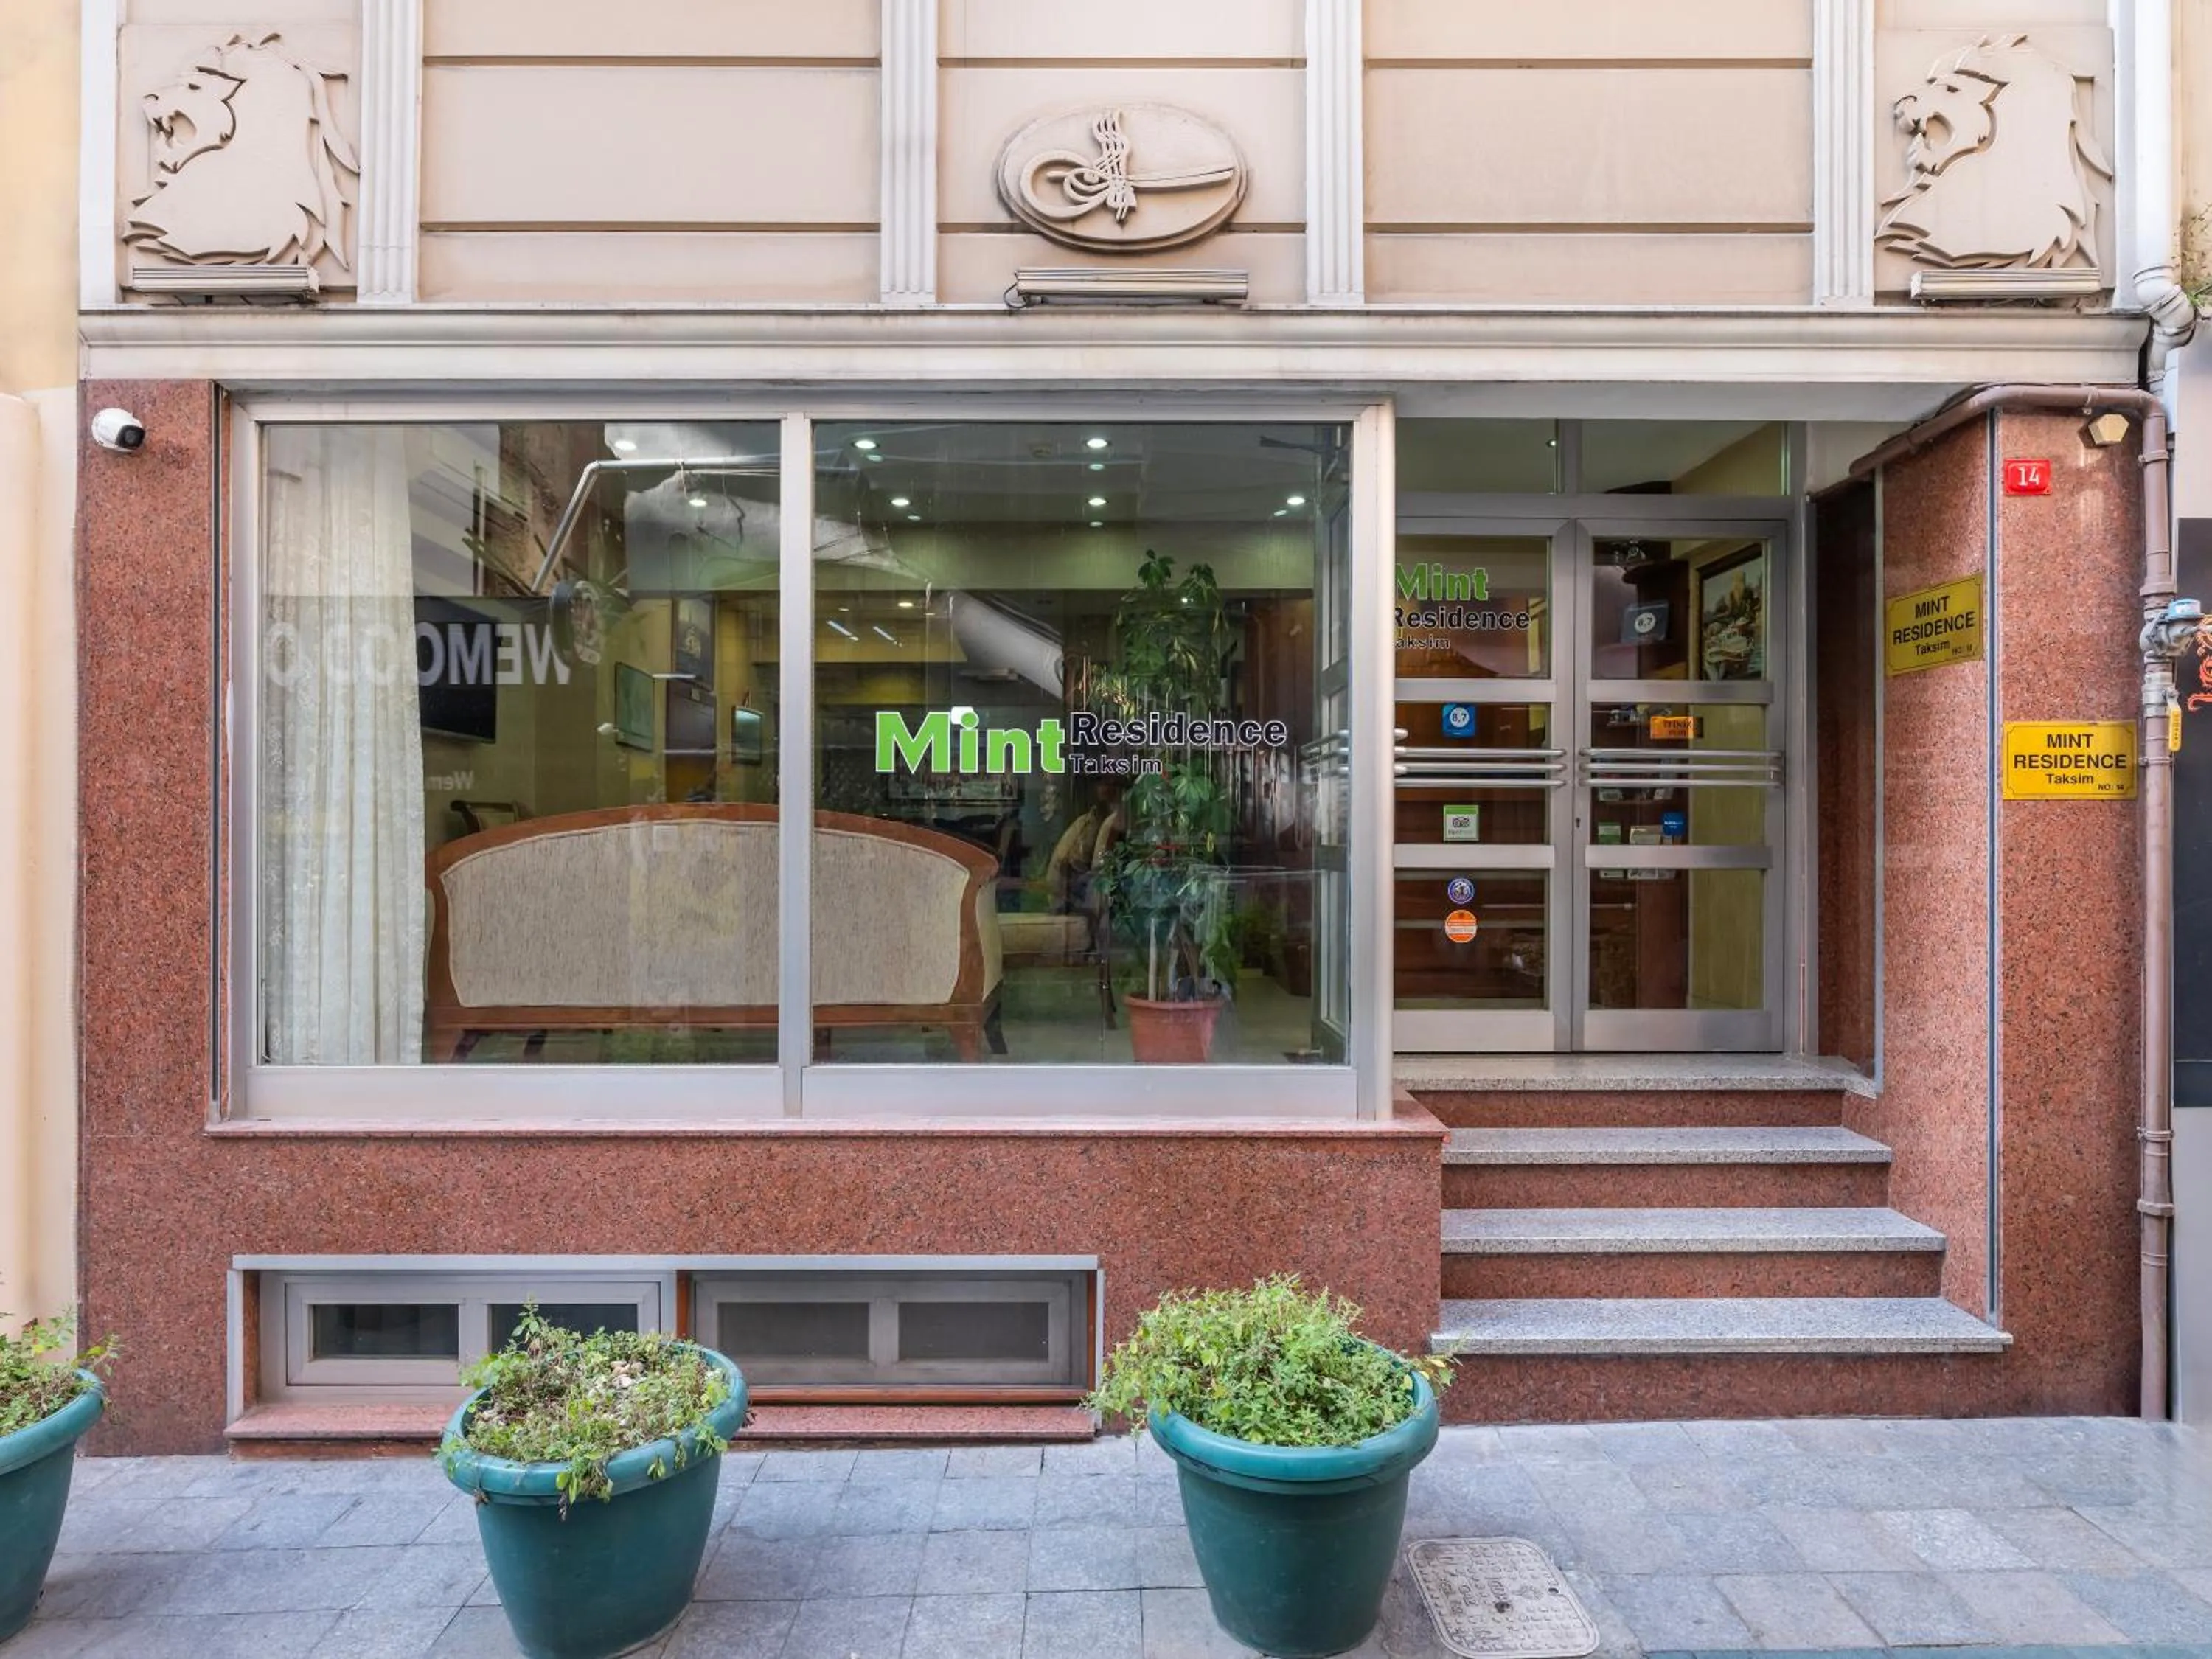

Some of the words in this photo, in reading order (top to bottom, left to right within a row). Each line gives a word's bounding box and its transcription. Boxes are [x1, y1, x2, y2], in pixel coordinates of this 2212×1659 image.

[2017, 467, 2040, 486] 14
[1394, 563, 1489, 601] Mint
[1915, 595, 1950, 619] MINT
[1893, 611, 1975, 645] RESIDENCE
[1394, 634, 1451, 649] aksim
[1916, 639, 1950, 655] Taksim
[1070, 712, 1287, 746] Residence
[875, 711, 1065, 774] Mint
[2047, 734, 2094, 748] MINT
[1069, 754, 1162, 774] Taksim
[2014, 754, 2127, 769] RESIDENCE
[2045, 773, 2094, 785] Taksim
